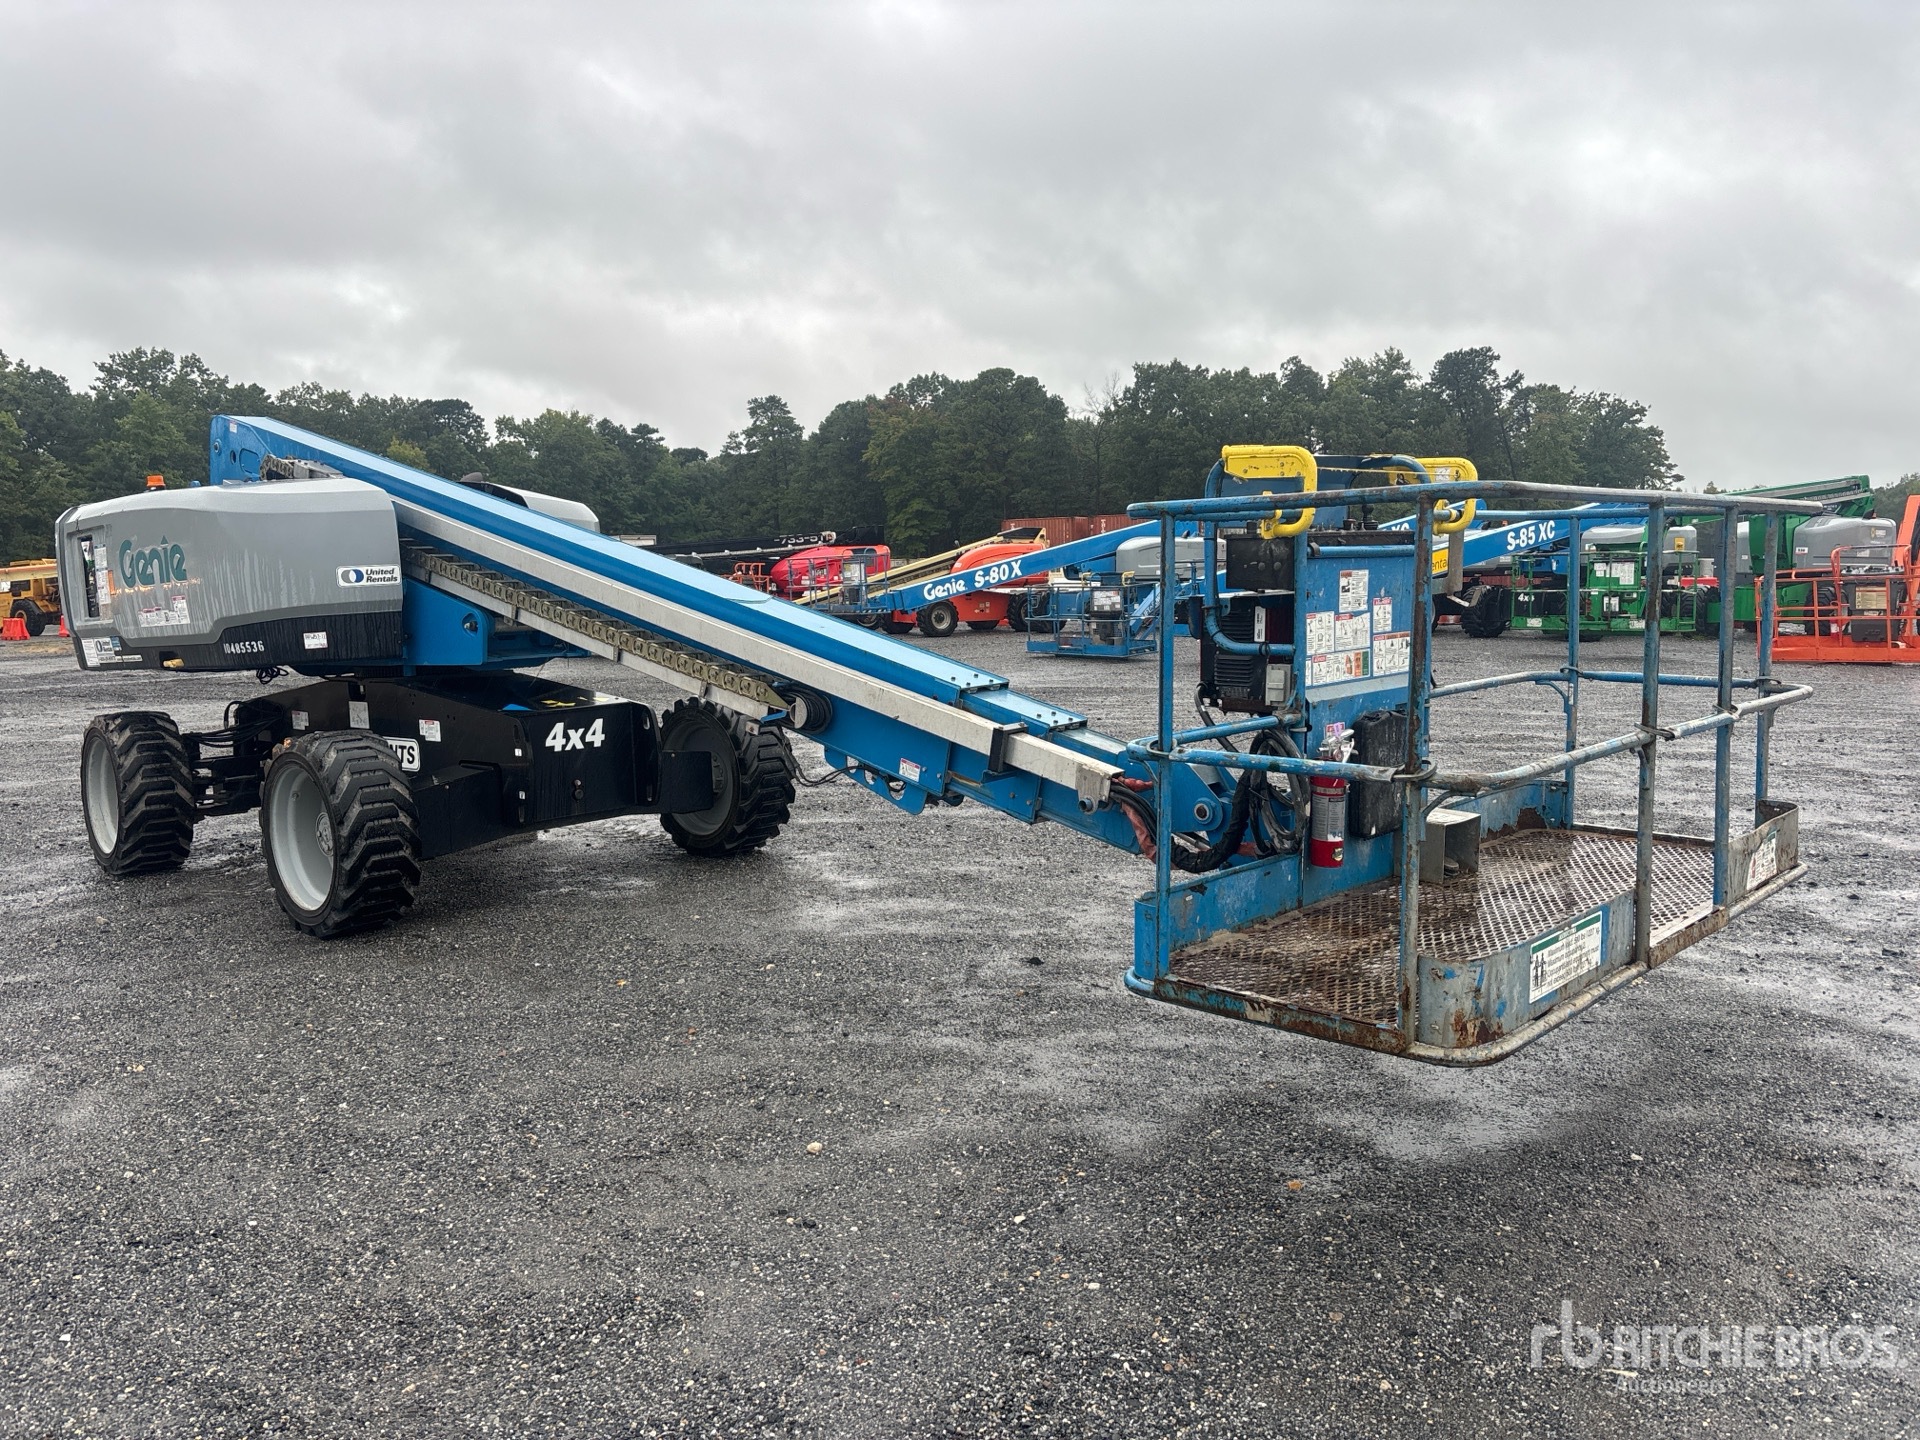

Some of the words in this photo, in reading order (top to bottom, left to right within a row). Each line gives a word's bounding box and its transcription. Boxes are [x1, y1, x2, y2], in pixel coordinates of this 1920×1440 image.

[1507, 525, 1536, 551] S-85
[1538, 520, 1556, 543] XC
[118, 535, 188, 588] Genie
[365, 567, 395, 575] United
[366, 575, 398, 583] Rentals
[923, 577, 966, 600] Genie
[973, 564, 1010, 588] S-80
[545, 718, 606, 752] 4x4
